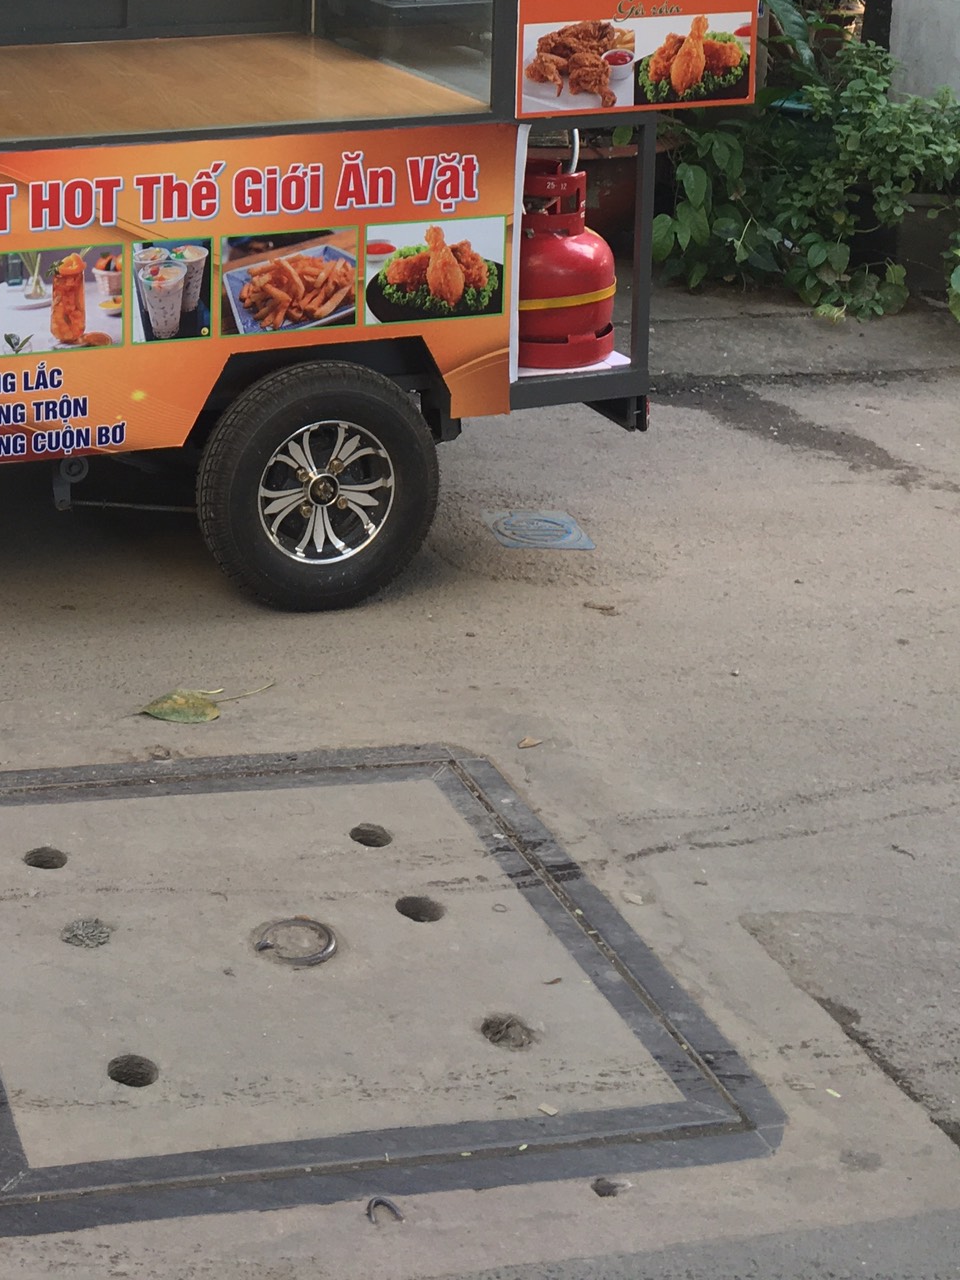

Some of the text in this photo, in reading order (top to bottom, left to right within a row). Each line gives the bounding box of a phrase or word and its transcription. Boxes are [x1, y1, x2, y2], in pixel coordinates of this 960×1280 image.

[29, 175, 124, 232] HOT
[134, 161, 226, 223] Thế
[233, 162, 324, 216] Giới
[334, 151, 395, 208] Ăn
[406, 152, 479, 213] Vặt
[22, 362, 63, 392] LẮC
[32, 394, 88, 423] TRỘN
[32, 425, 91, 455] CUỘN
[97, 422, 127, 447] BƠ
